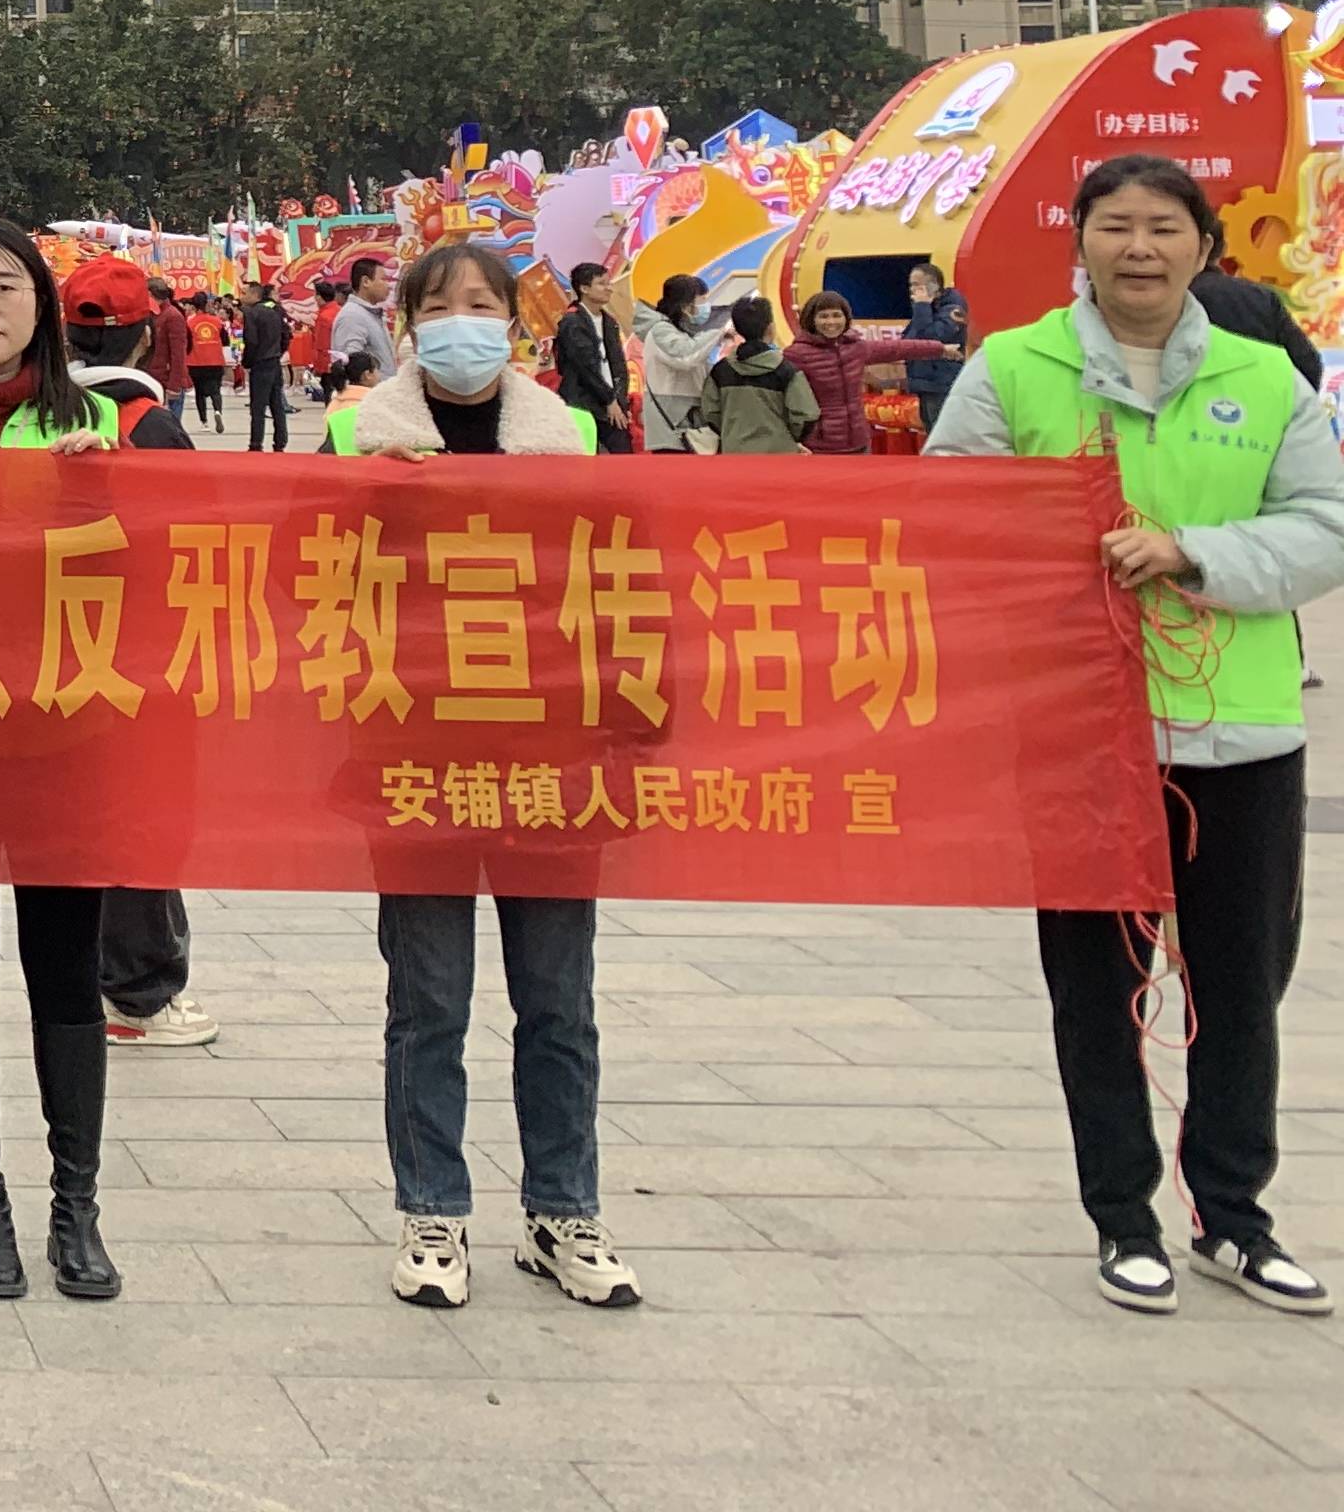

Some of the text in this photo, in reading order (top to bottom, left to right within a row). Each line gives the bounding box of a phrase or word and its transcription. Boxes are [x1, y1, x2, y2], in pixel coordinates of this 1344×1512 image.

[381, 759, 901, 835] 安铺镇人民政府 宣
